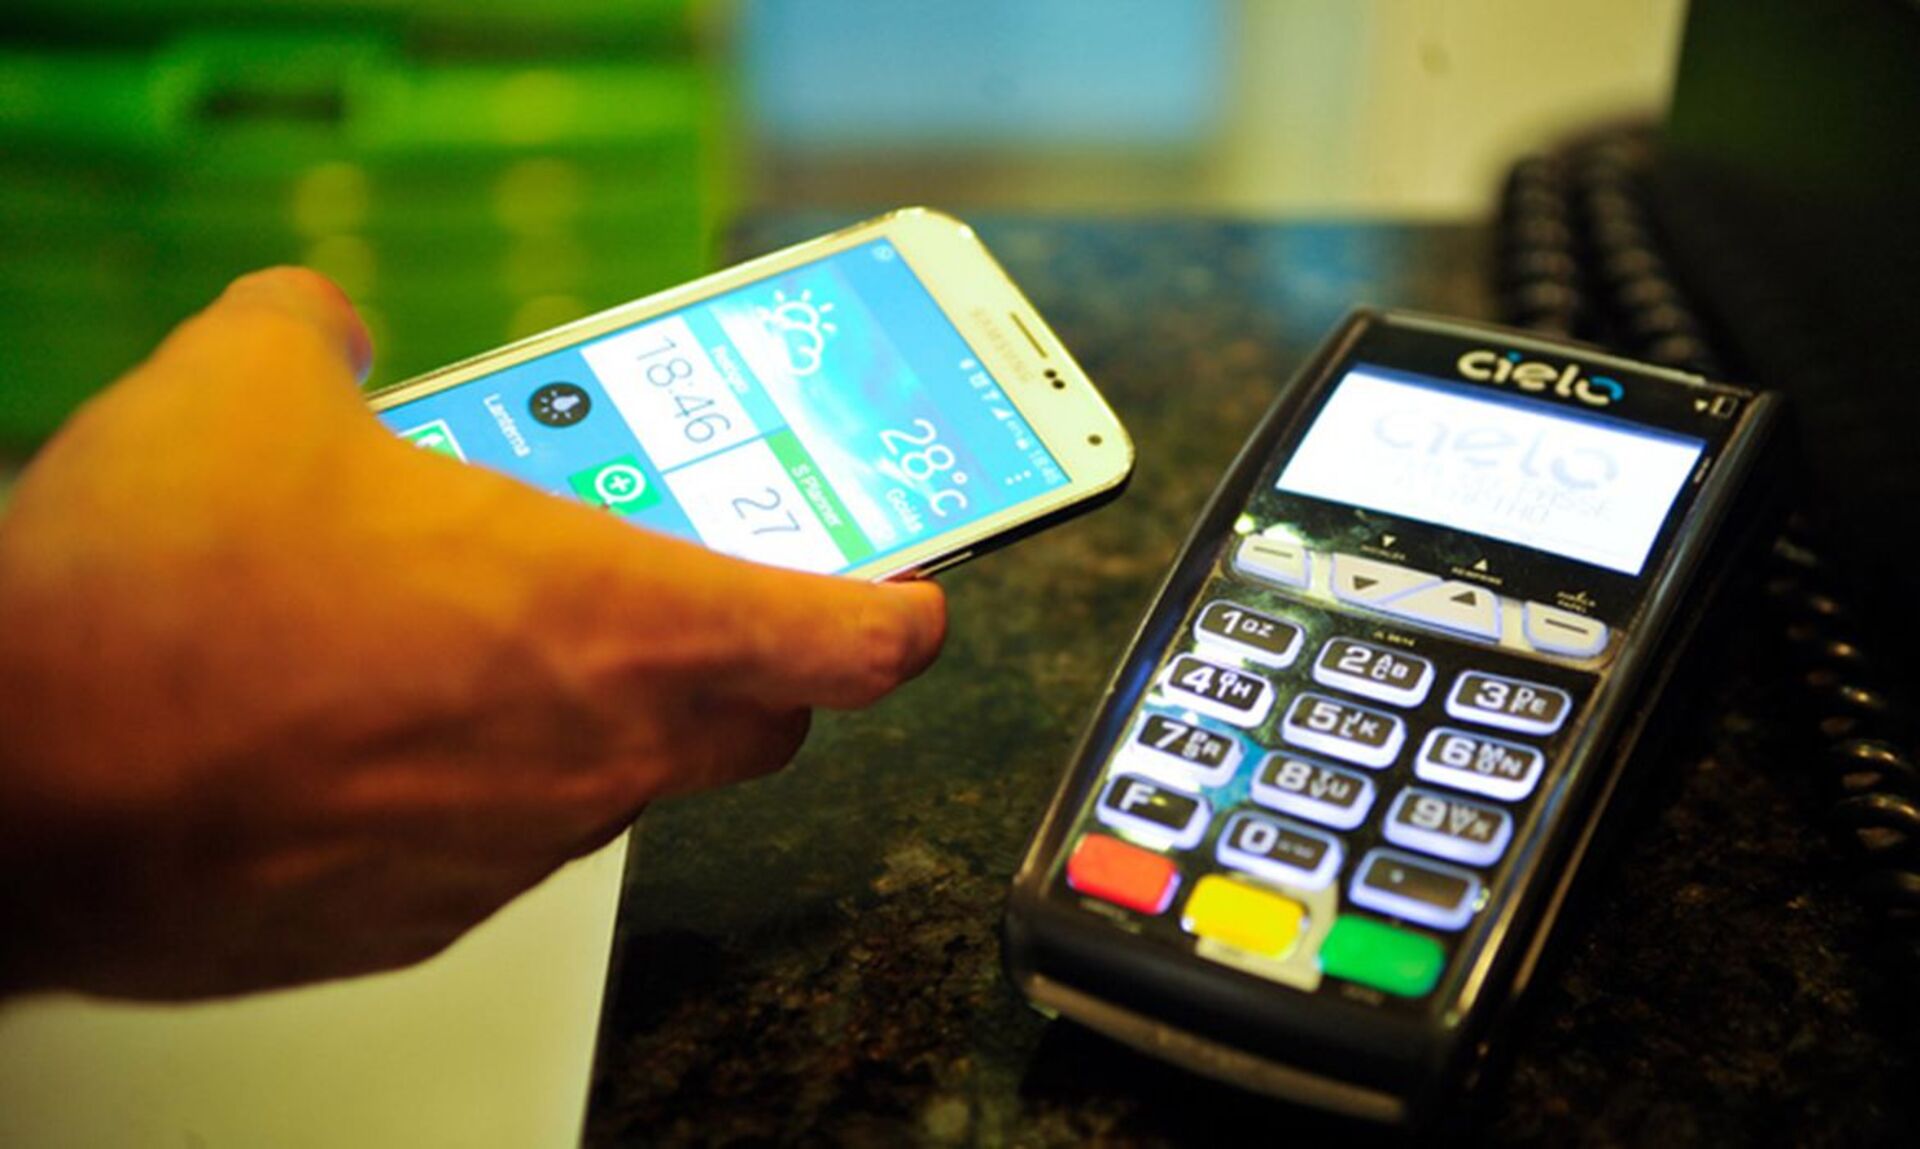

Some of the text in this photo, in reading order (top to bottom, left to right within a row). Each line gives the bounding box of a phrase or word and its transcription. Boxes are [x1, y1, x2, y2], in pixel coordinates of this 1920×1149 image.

[637, 336, 731, 443] 18:46
[1457, 350, 1624, 405] cielo
[732, 488, 800, 534] 27
